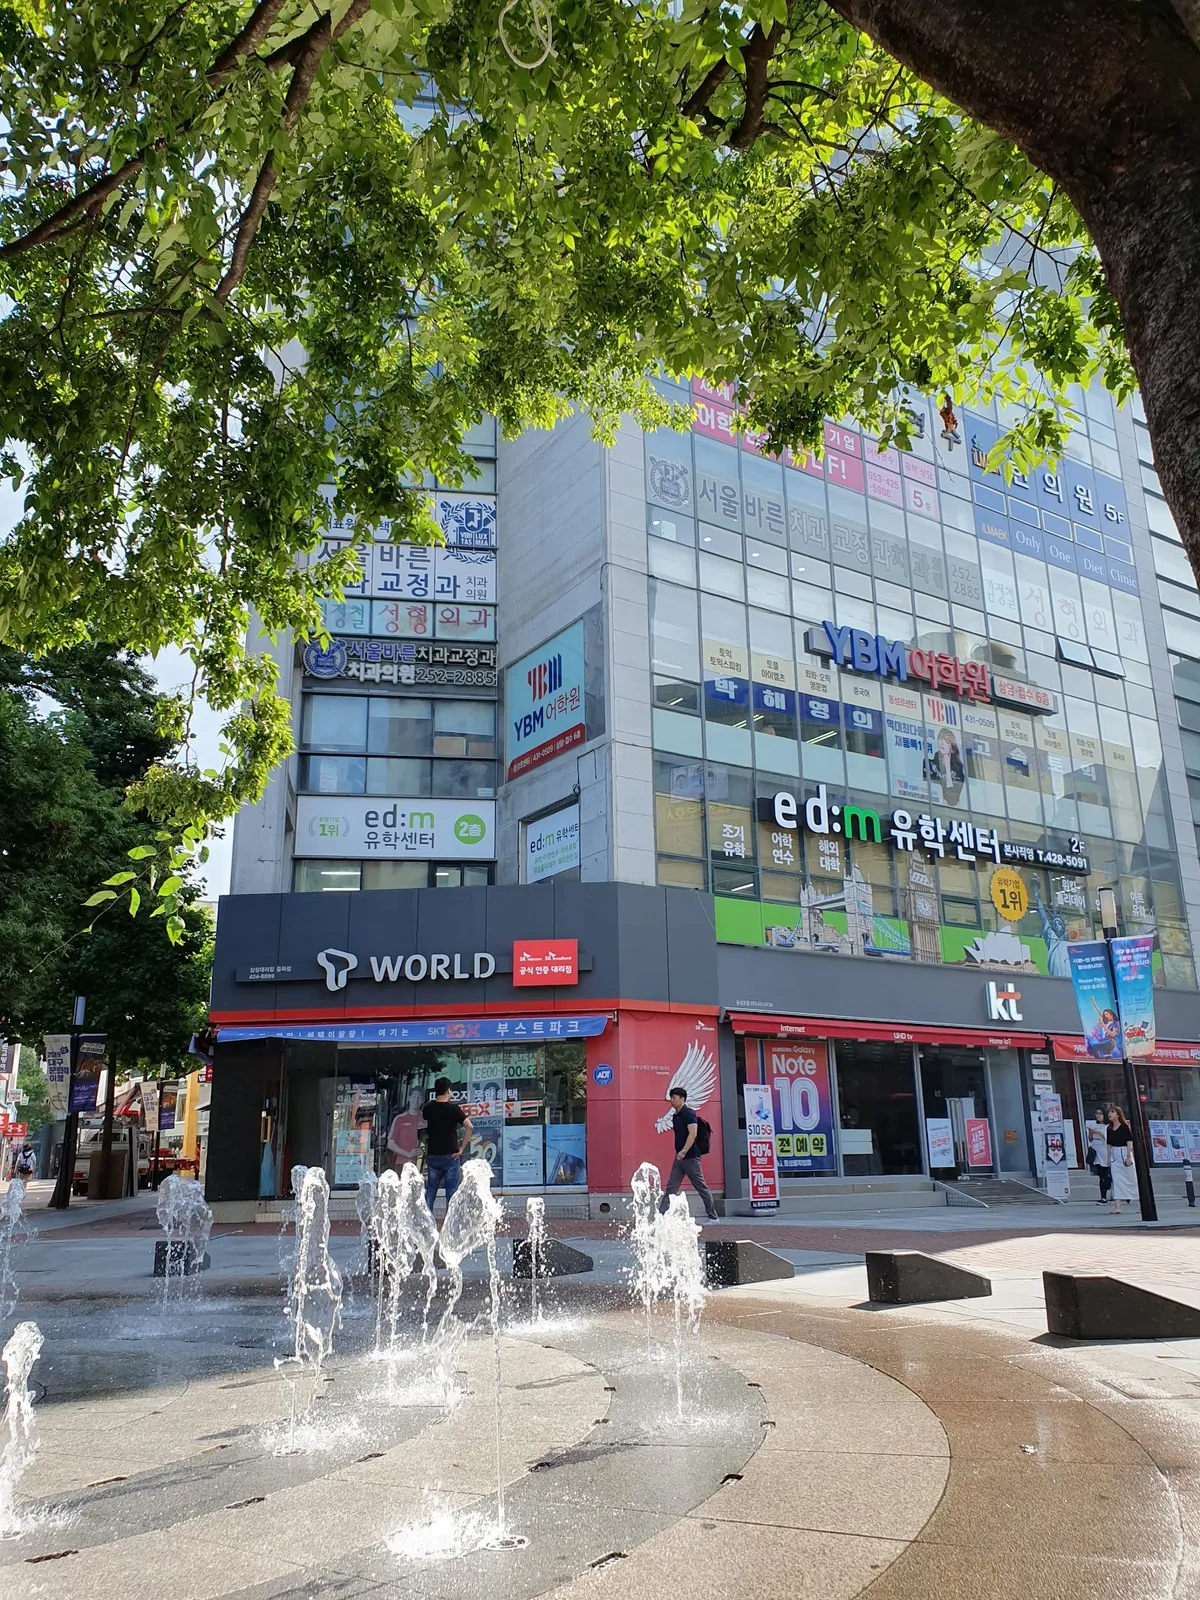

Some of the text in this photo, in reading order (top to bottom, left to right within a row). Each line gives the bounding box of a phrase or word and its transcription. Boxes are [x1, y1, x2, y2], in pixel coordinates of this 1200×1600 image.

[829, 427, 855, 452] 기업
[867, 470, 900, 490] 053-425
[919, 467, 934, 480] 상담
[868, 484, 891, 498] -5900
[1104, 502, 1124, 525] 5F
[460, 538, 474, 546] TAS
[475, 533, 488, 541] LUX
[1015, 525, 1042, 553] Only
[1049, 544, 1072, 564] One
[1083, 557, 1104, 577] Diet
[1110, 568, 1138, 589] Clinic
[465, 575, 488, 587] 치과
[950, 563, 978, 583] 252-
[465, 588, 488, 600] 의원
[953, 581, 981, 601] 2885
[378, 603, 492, 635] 성형외과
[718, 647, 733, 659] 토익
[819, 619, 992, 704] YBM 어학원
[709, 656, 742, 673] 토익스피킹
[766, 660, 780, 671] 토플
[852, 686, 871, 699] 중국어
[1035, 691, 1052, 707] 6층
[887, 695, 918, 711] 동성로센터
[513, 684, 581, 742] YBM 어학원
[963, 713, 995, 730] 431-0509
[532, 744, 554, 761] 431-0509
[364, 803, 435, 830] ed:m
[774, 783, 1000, 864] ed:m 유학센터
[318, 823, 340, 838] 1위
[458, 820, 483, 838] 2층
[722, 823, 746, 842] 조기
[364, 830, 436, 851] 유학센터
[530, 832, 556, 854] ed:m
[722, 840, 746, 859] 유학
[771, 832, 794, 850] 어학
[817, 839, 840, 857] 해외
[1069, 836, 1086, 854] 2F
[771, 848, 795, 866] 연수
[819, 856, 841, 874] 대학
[1002, 843, 1088, 870] 본사직영 T.428-5091
[997, 877, 1021, 890] 유학기업
[1000, 887, 1024, 912] 1위
[369, 952, 497, 982] WORLD
[519, 964, 573, 976] 공식 인증 대리점
[985, 980, 1023, 1022] kt
[378, 1028, 411, 1038] 여기는
[427, 1026, 446, 1037] SKT
[445, 1023, 481, 1039] 5GX
[496, 1019, 581, 1037] 부스트파크
[780, 1024, 806, 1034] Internet
[893, 1031, 914, 1041] UHD tv
[988, 1036, 1003, 1045] Home
[792, 1045, 816, 1055] Galaxy
[48, 1058, 64, 1067] 대구
[771, 1053, 817, 1076] Note
[596, 1070, 611, 1080] ADT
[474, 1088, 496, 1102] 못할
[496, 1088, 518, 1101] 혜택
[773, 1076, 821, 1131] 10
[747, 1124, 773, 1136] S10 5G
[750, 1143, 772, 1157] 50%
